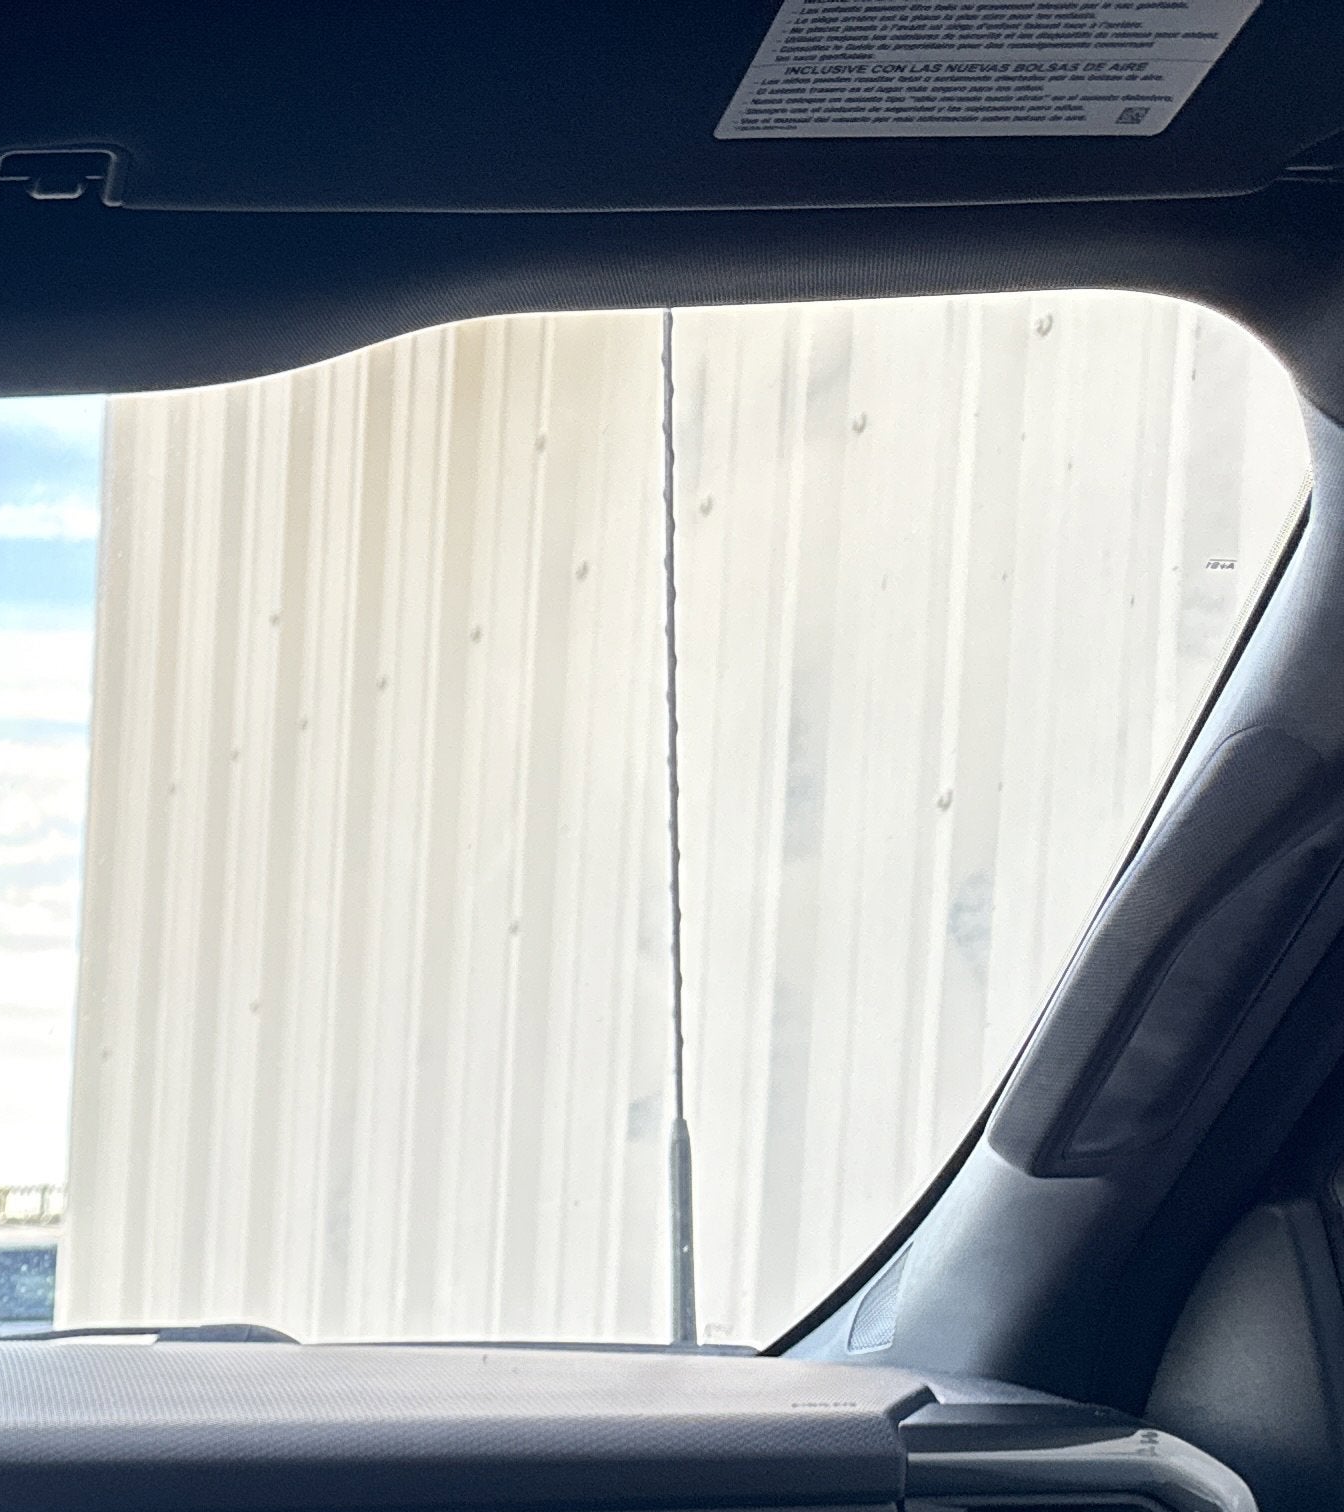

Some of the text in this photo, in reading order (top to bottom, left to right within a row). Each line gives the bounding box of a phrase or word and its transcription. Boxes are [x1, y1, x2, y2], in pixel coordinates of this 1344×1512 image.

[784, 63, 1149, 75] INCLUSIVE CON LAS NUEVAS BOLSAS DE AIRE
